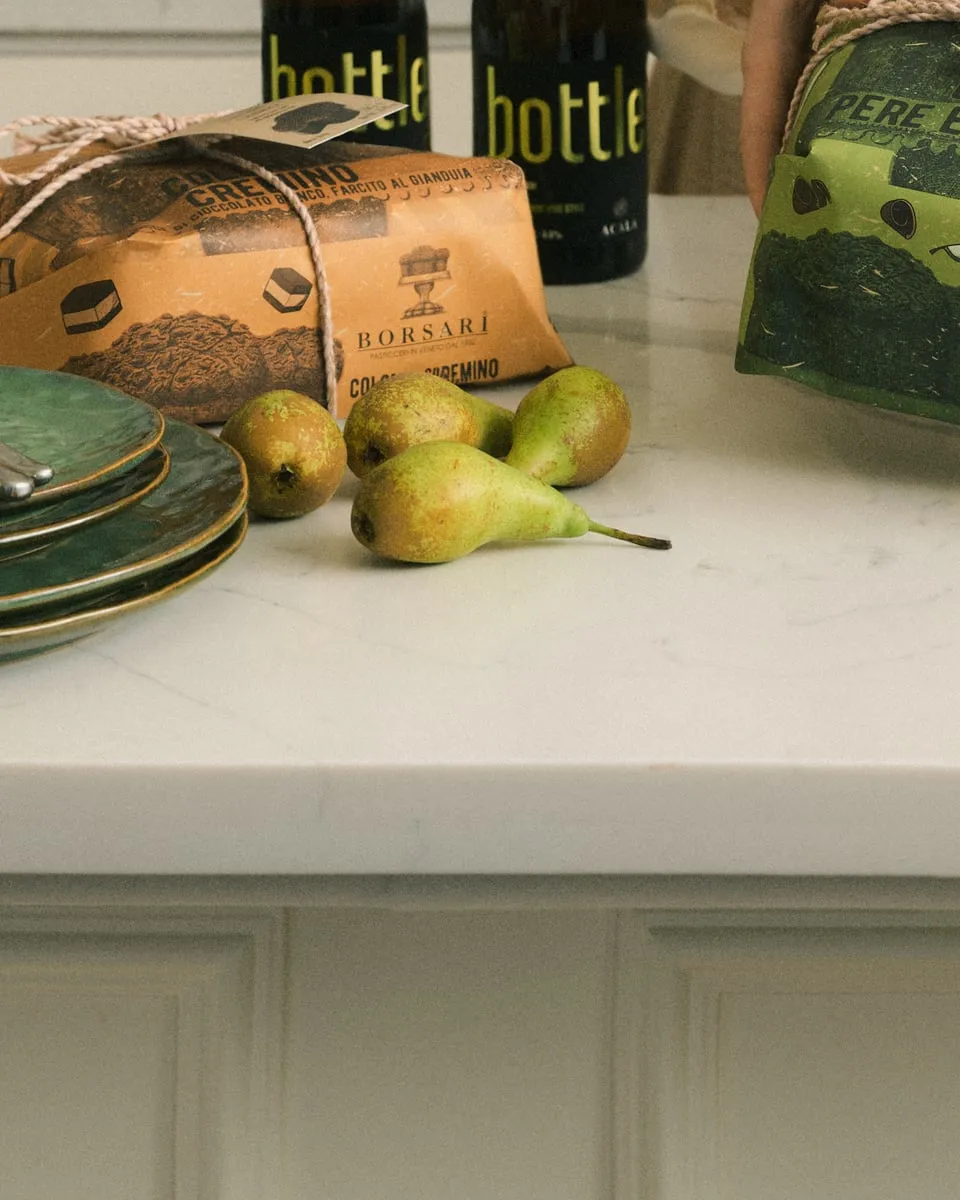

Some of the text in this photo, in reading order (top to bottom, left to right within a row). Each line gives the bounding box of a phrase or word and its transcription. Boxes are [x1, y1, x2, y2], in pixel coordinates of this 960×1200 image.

[487, 65, 646, 164] bottle
[823, 93, 935, 131] PERE
[332, 179, 388, 197] FARCITO
[391, 176, 408, 191] AL
[408, 167, 472, 186] GIANDUIA
